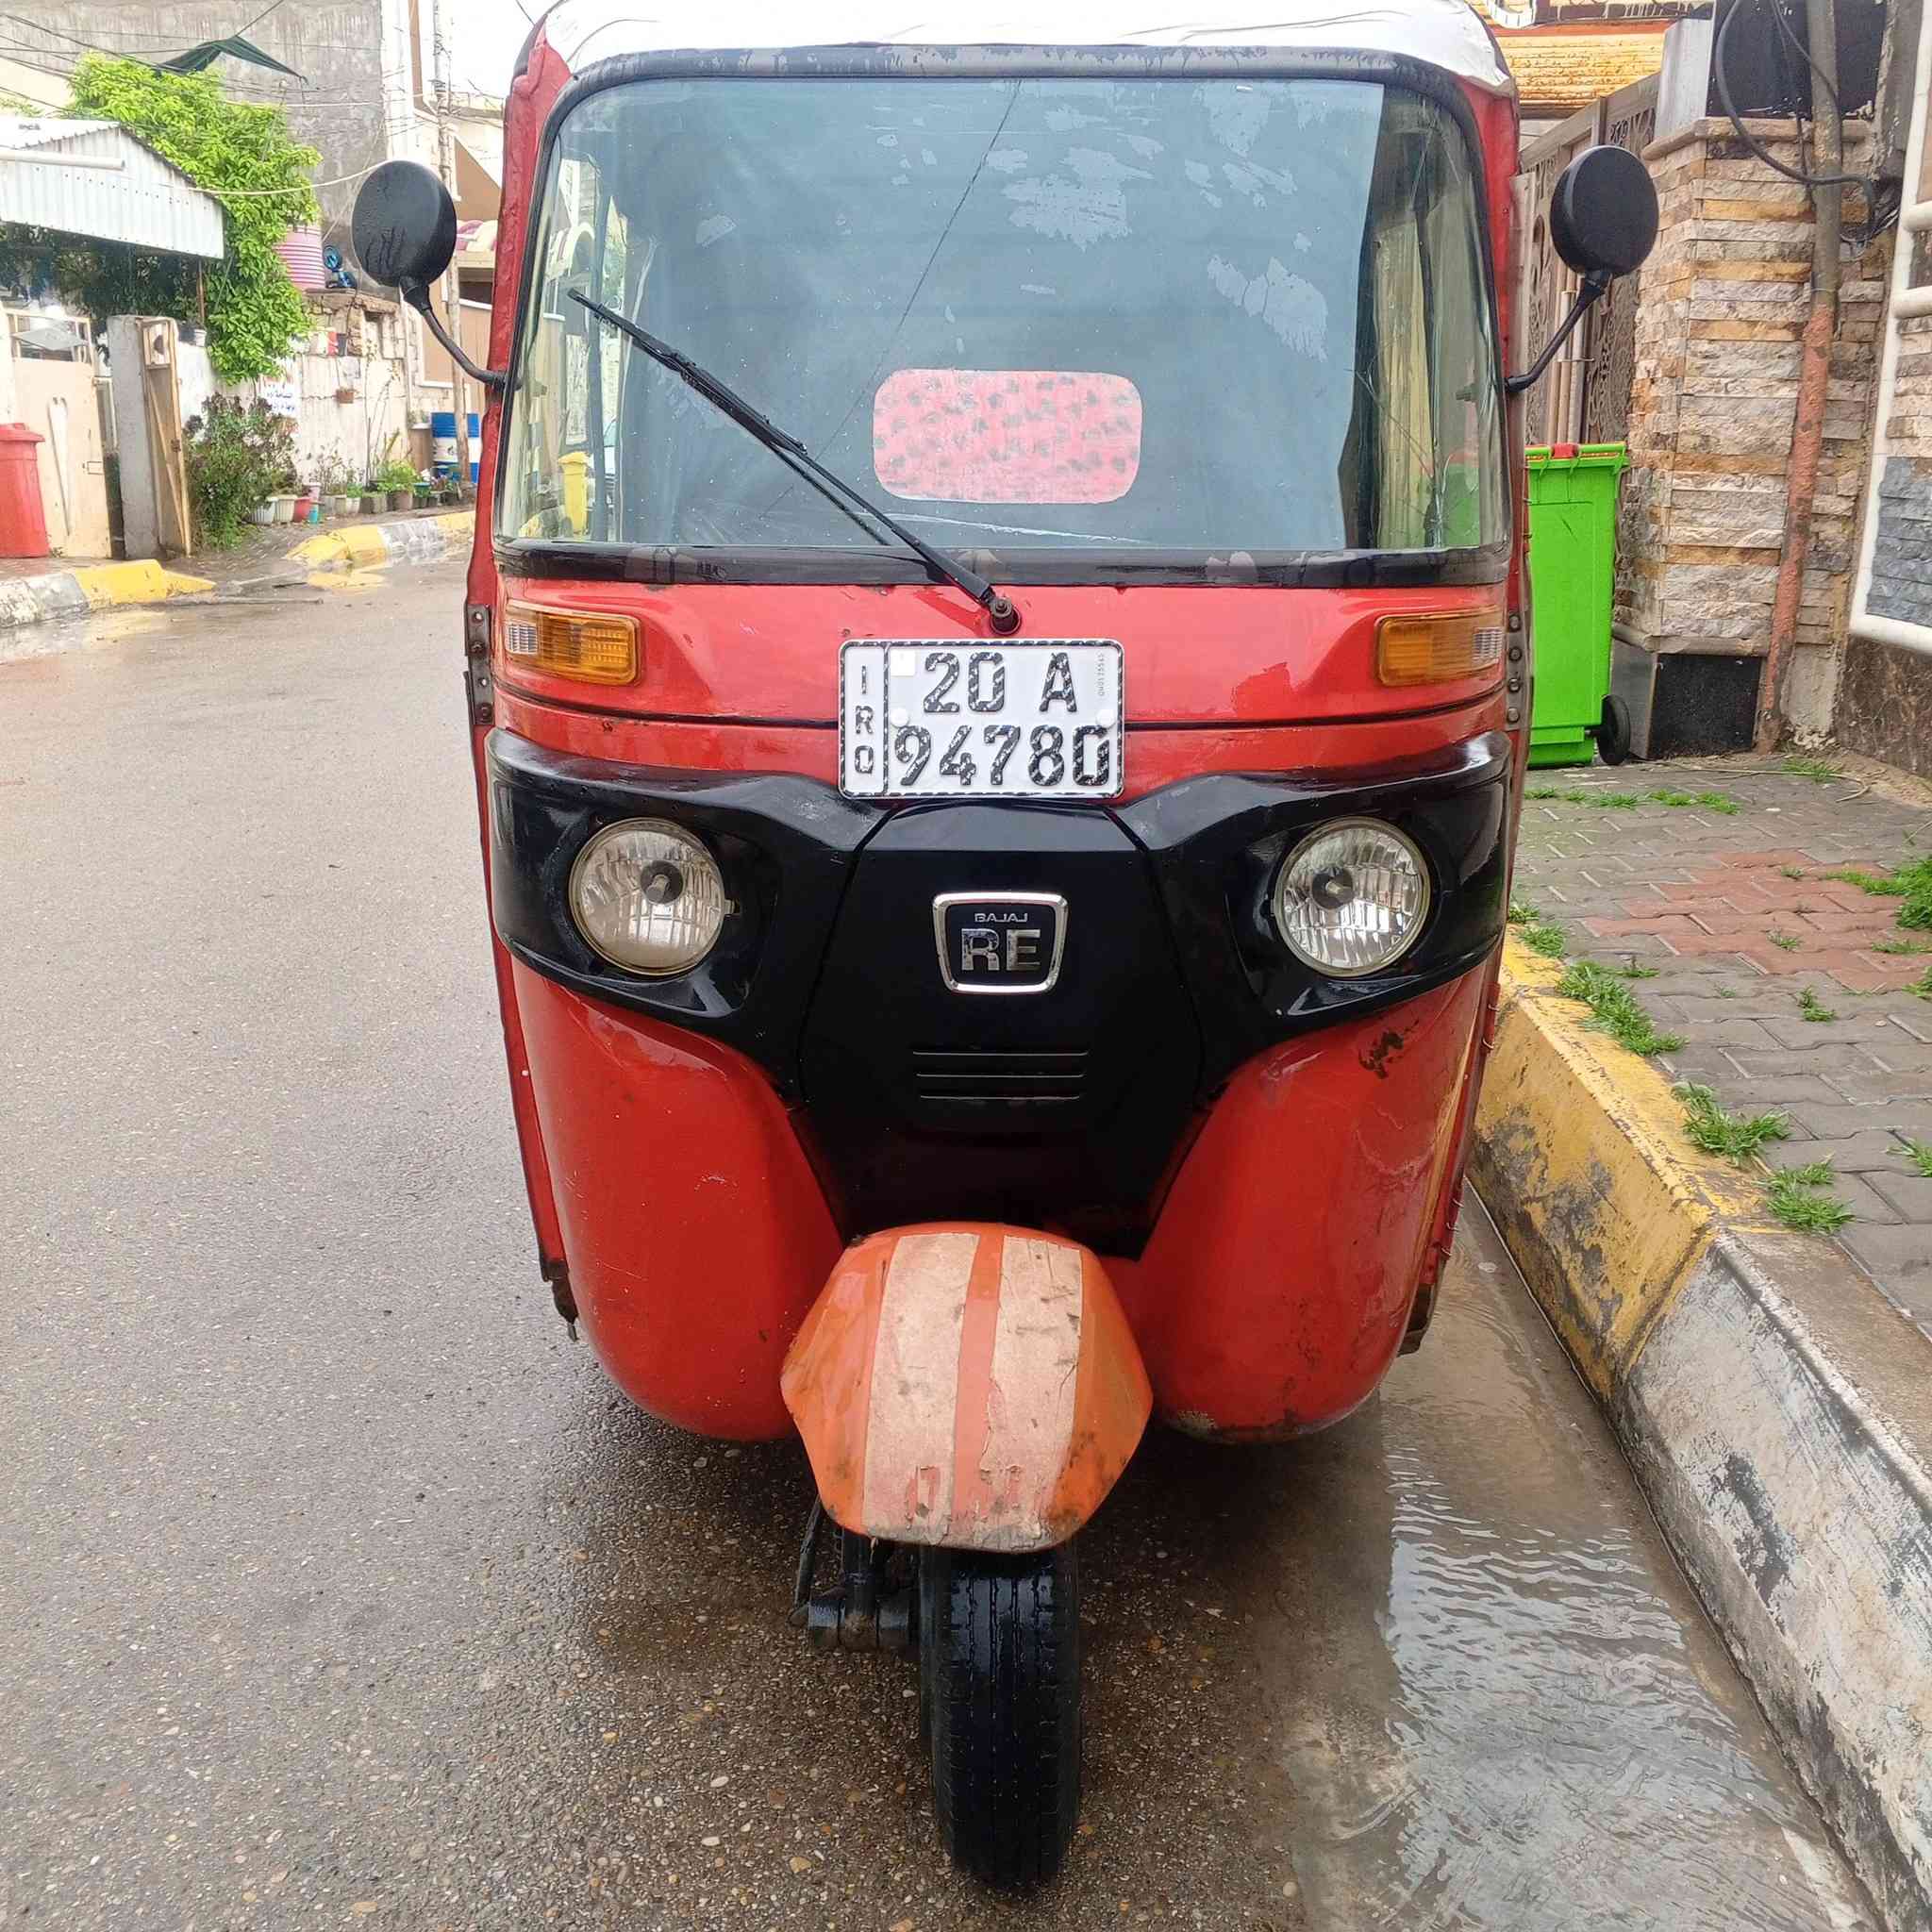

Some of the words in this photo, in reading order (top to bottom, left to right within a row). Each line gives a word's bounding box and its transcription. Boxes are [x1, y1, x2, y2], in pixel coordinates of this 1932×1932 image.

[924, 651, 1005, 712] 20
[1039, 651, 1077, 712] A
[895, 724, 1110, 786] 94780
[974, 912, 1028, 923] BAJAJ
[961, 928, 1041, 971] RE
